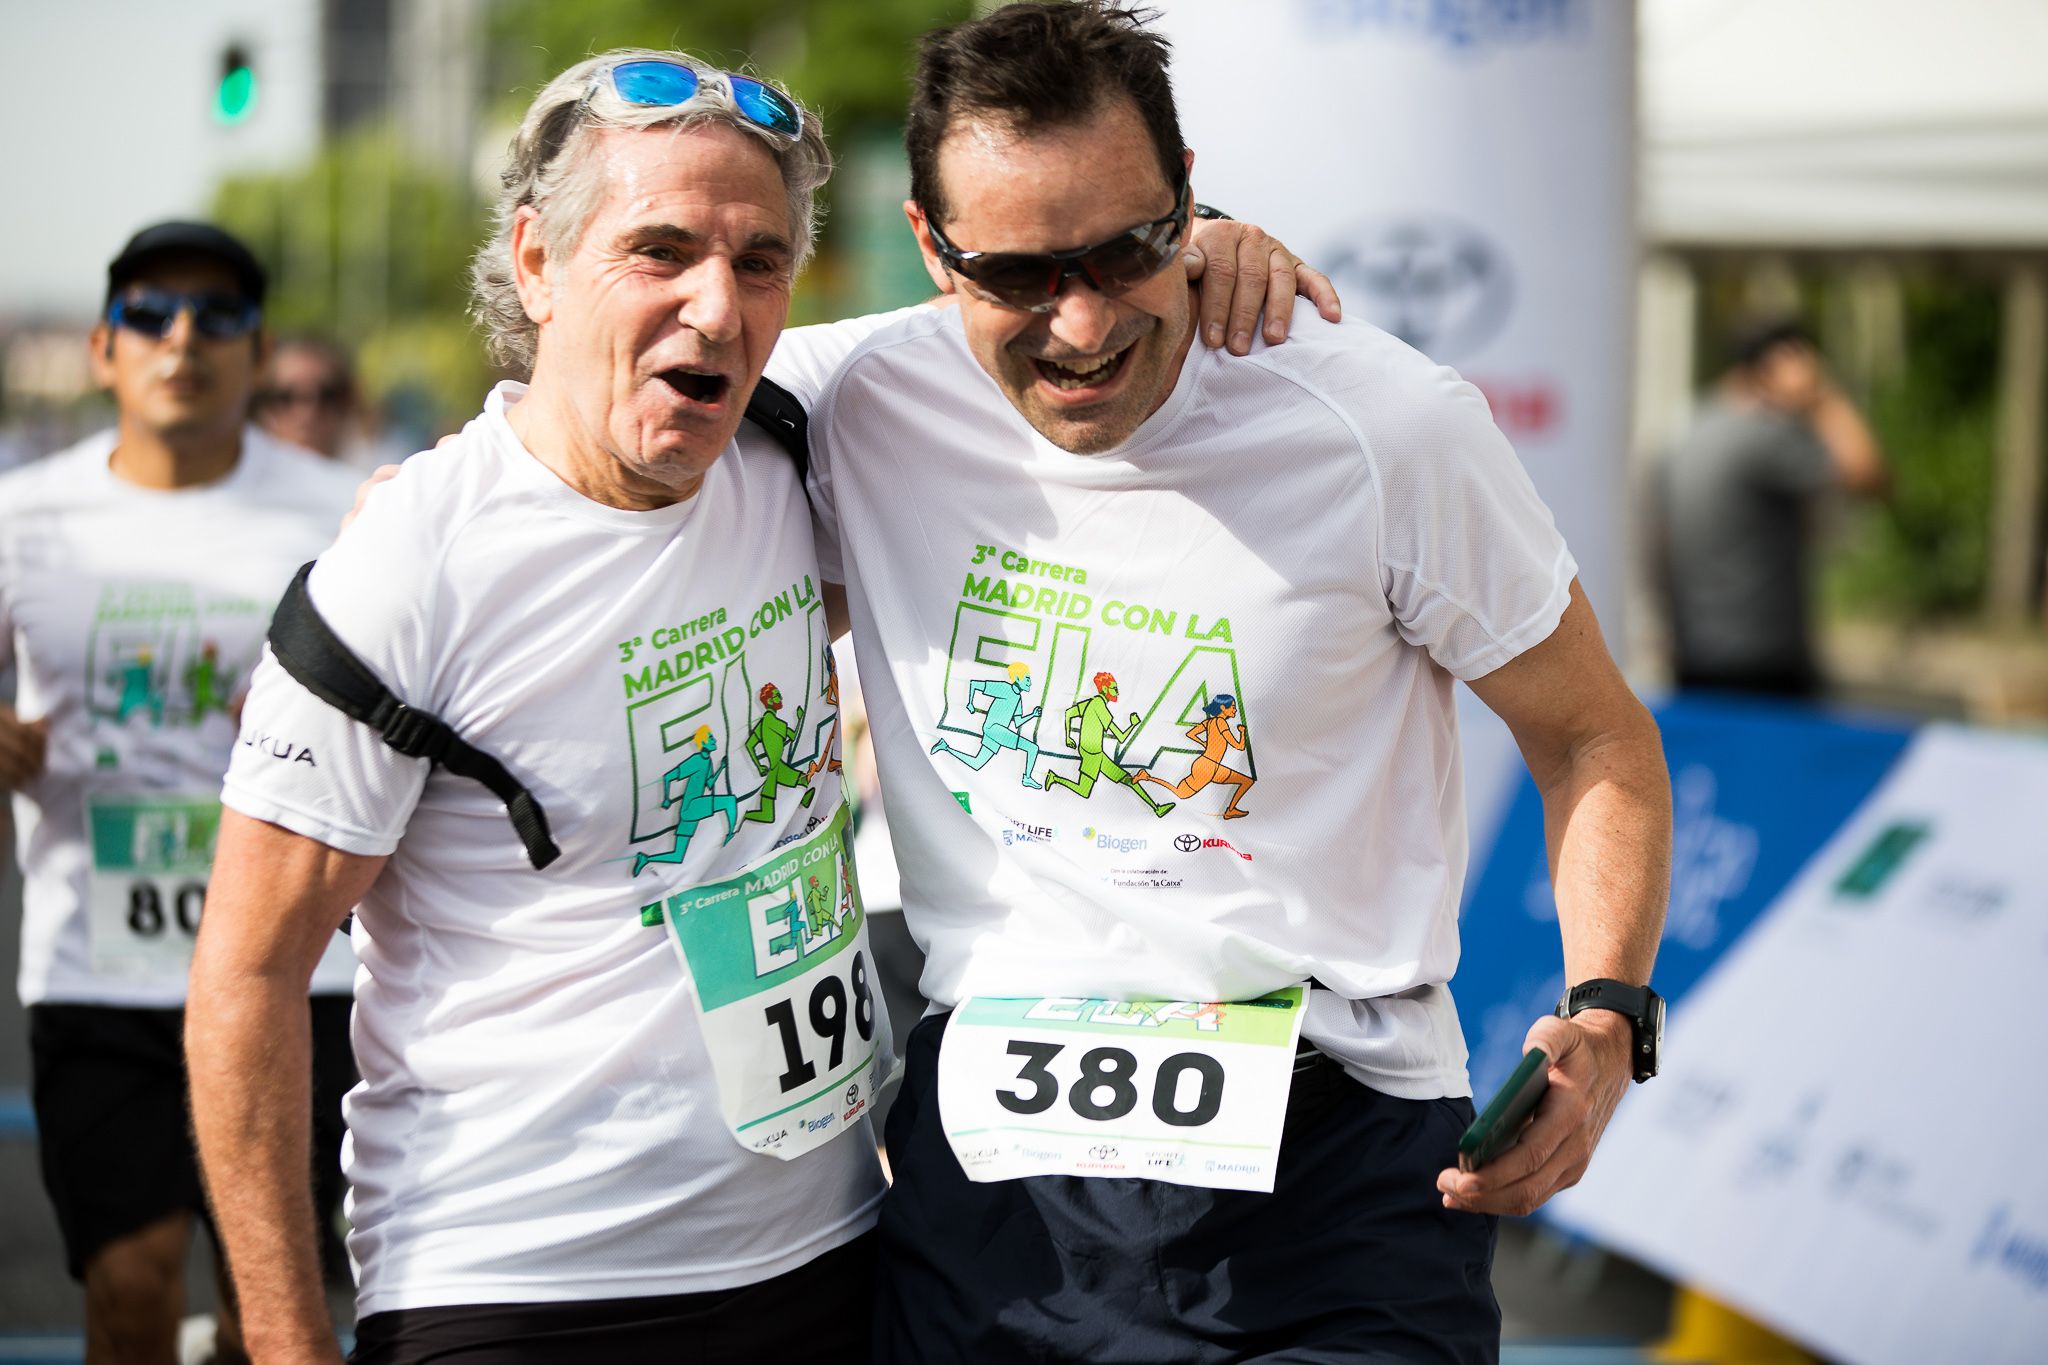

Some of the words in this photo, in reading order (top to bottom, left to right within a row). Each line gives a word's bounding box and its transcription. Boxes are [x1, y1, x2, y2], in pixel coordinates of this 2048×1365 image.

[1001, 550, 1088, 585] Carrera
[651, 607, 727, 650] Carrera
[962, 573, 1092, 619] MADRID
[1101, 600, 1178, 636] CON
[1185, 614, 1233, 643] LA
[623, 626, 745, 699] MADRID
[750, 598, 793, 639] CON
[793, 574, 816, 609] LA
[937, 600, 1257, 783] ELA
[1027, 825, 1053, 838] LIFE
[1097, 834, 1147, 853] Biogen
[695, 887, 740, 909] Carrera
[744, 858, 800, 896] MADRID
[802, 841, 830, 867] CON
[830, 833, 839, 851] LA
[1113, 879, 1149, 887] Fundación
[764, 950, 876, 1094] 198
[995, 1039, 1225, 1127] 380
[808, 1112, 836, 1133] Biogen
[1216, 1163, 1261, 1174] MADRID
